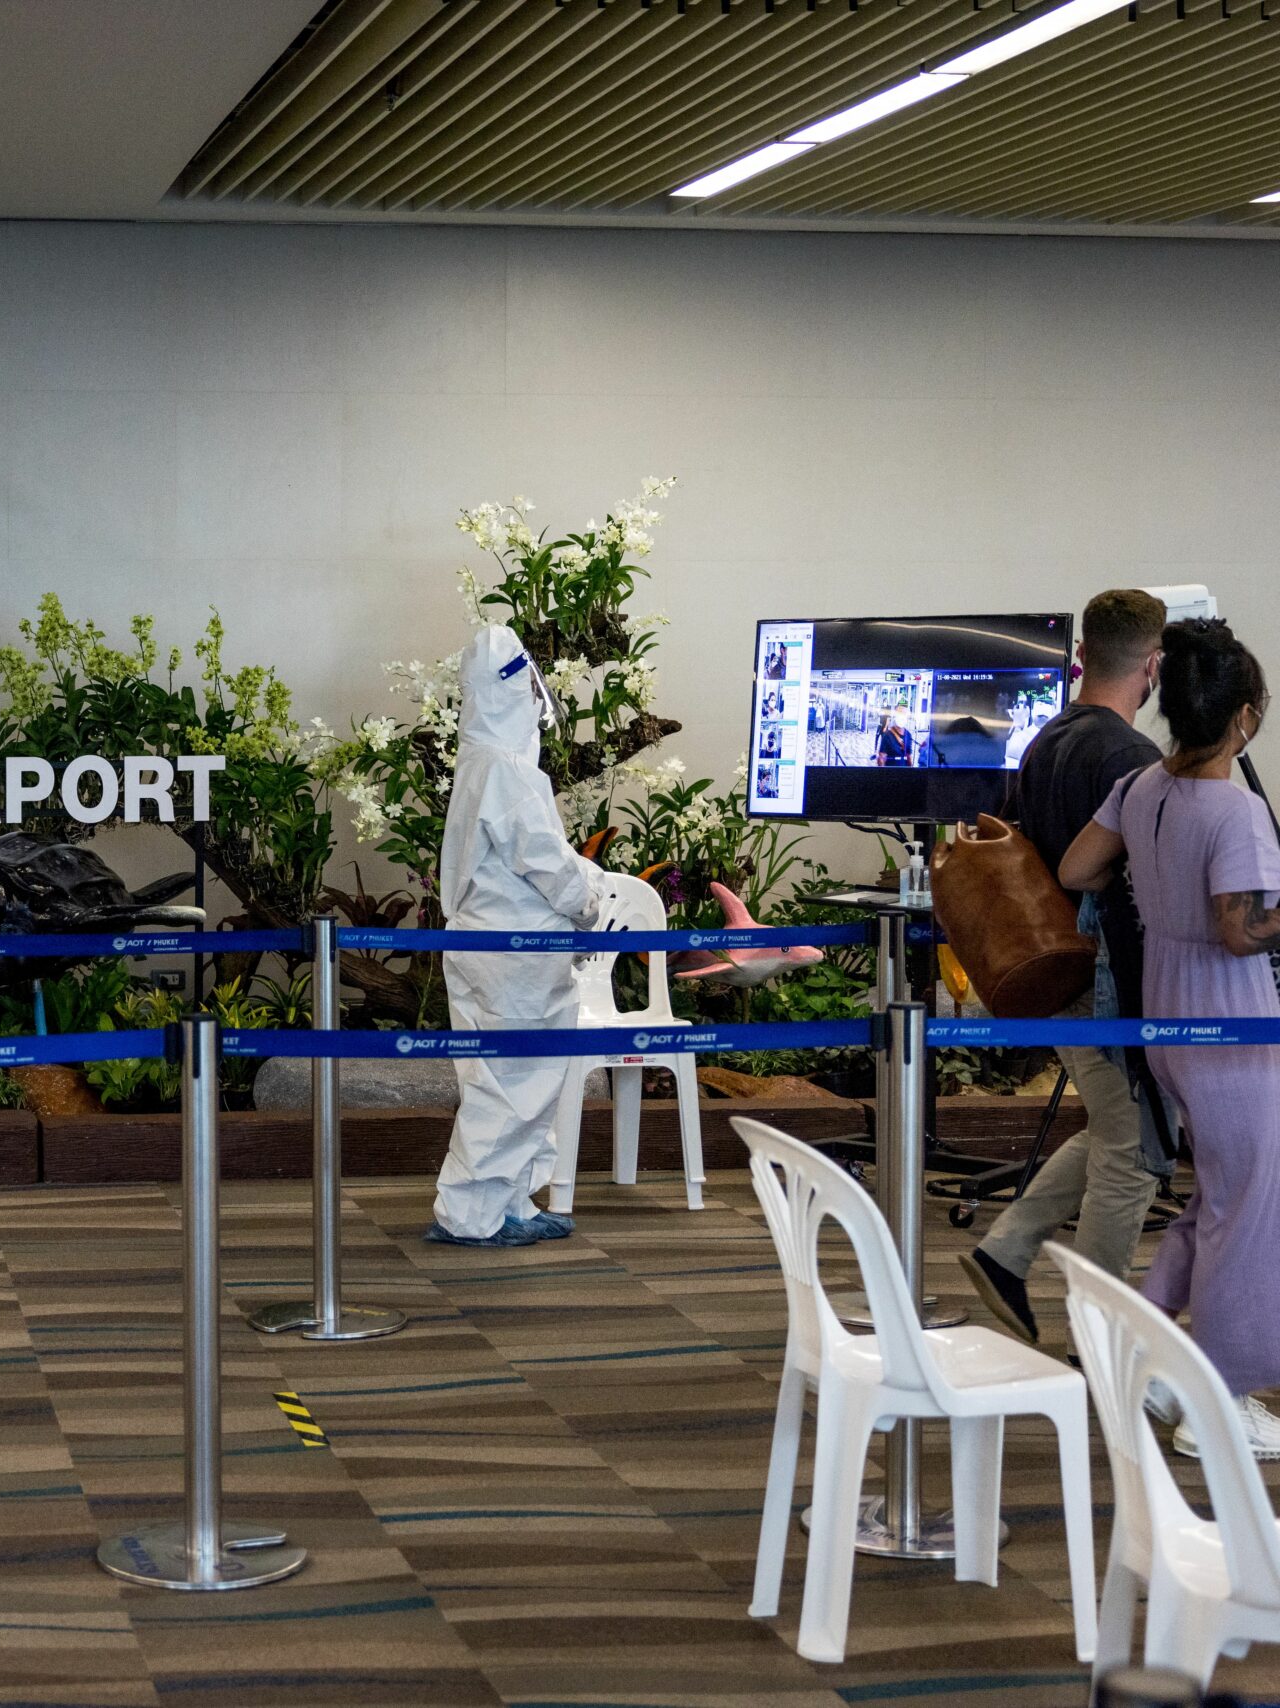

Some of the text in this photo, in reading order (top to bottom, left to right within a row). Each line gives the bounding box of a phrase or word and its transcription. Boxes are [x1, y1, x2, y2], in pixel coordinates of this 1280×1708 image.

[153, 938, 179, 946] PHUKET
[927, 1027, 950, 1036] AOT
[1158, 1027, 1180, 1035] AOT
[1190, 1026, 1222, 1035] PHUKET
[650, 1035, 673, 1044] AOT
[684, 1033, 718, 1042] PHUKET
[414, 1039, 437, 1048] AOT
[447, 1039, 481, 1048] PHUKET
